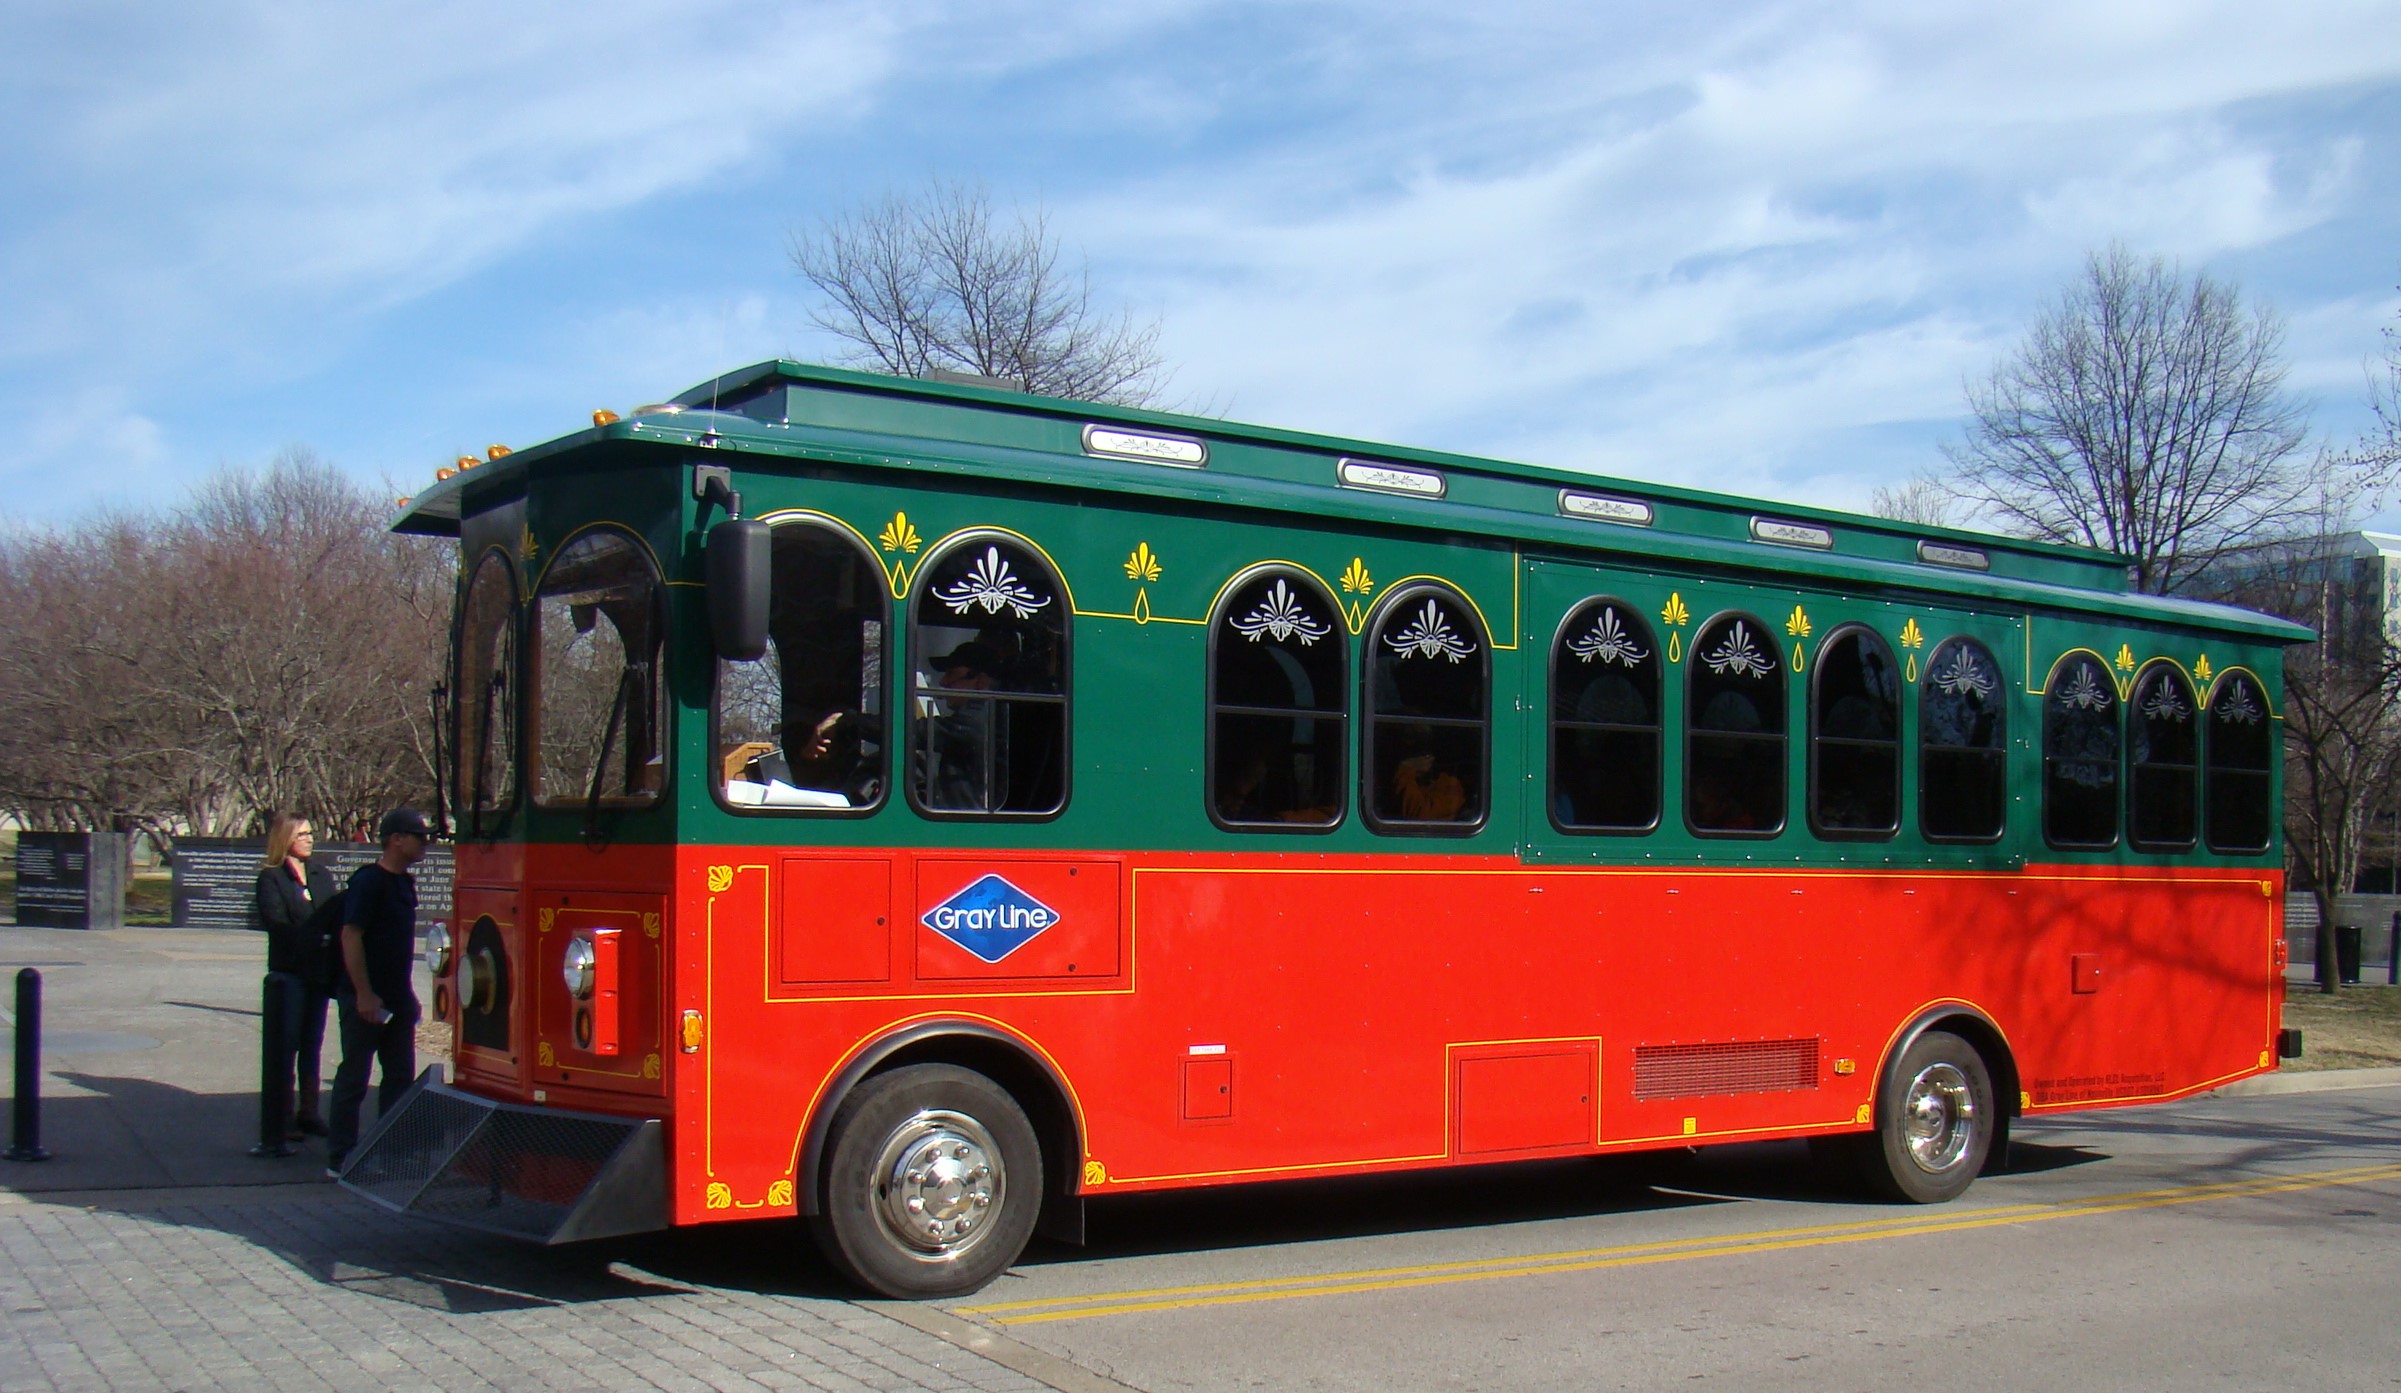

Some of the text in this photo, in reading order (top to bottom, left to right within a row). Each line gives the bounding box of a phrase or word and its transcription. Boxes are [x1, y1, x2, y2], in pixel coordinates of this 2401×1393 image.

[337, 855, 376, 863] Governor
[440, 903, 452, 911] Ap
[935, 904, 1048, 930] Gray Line
